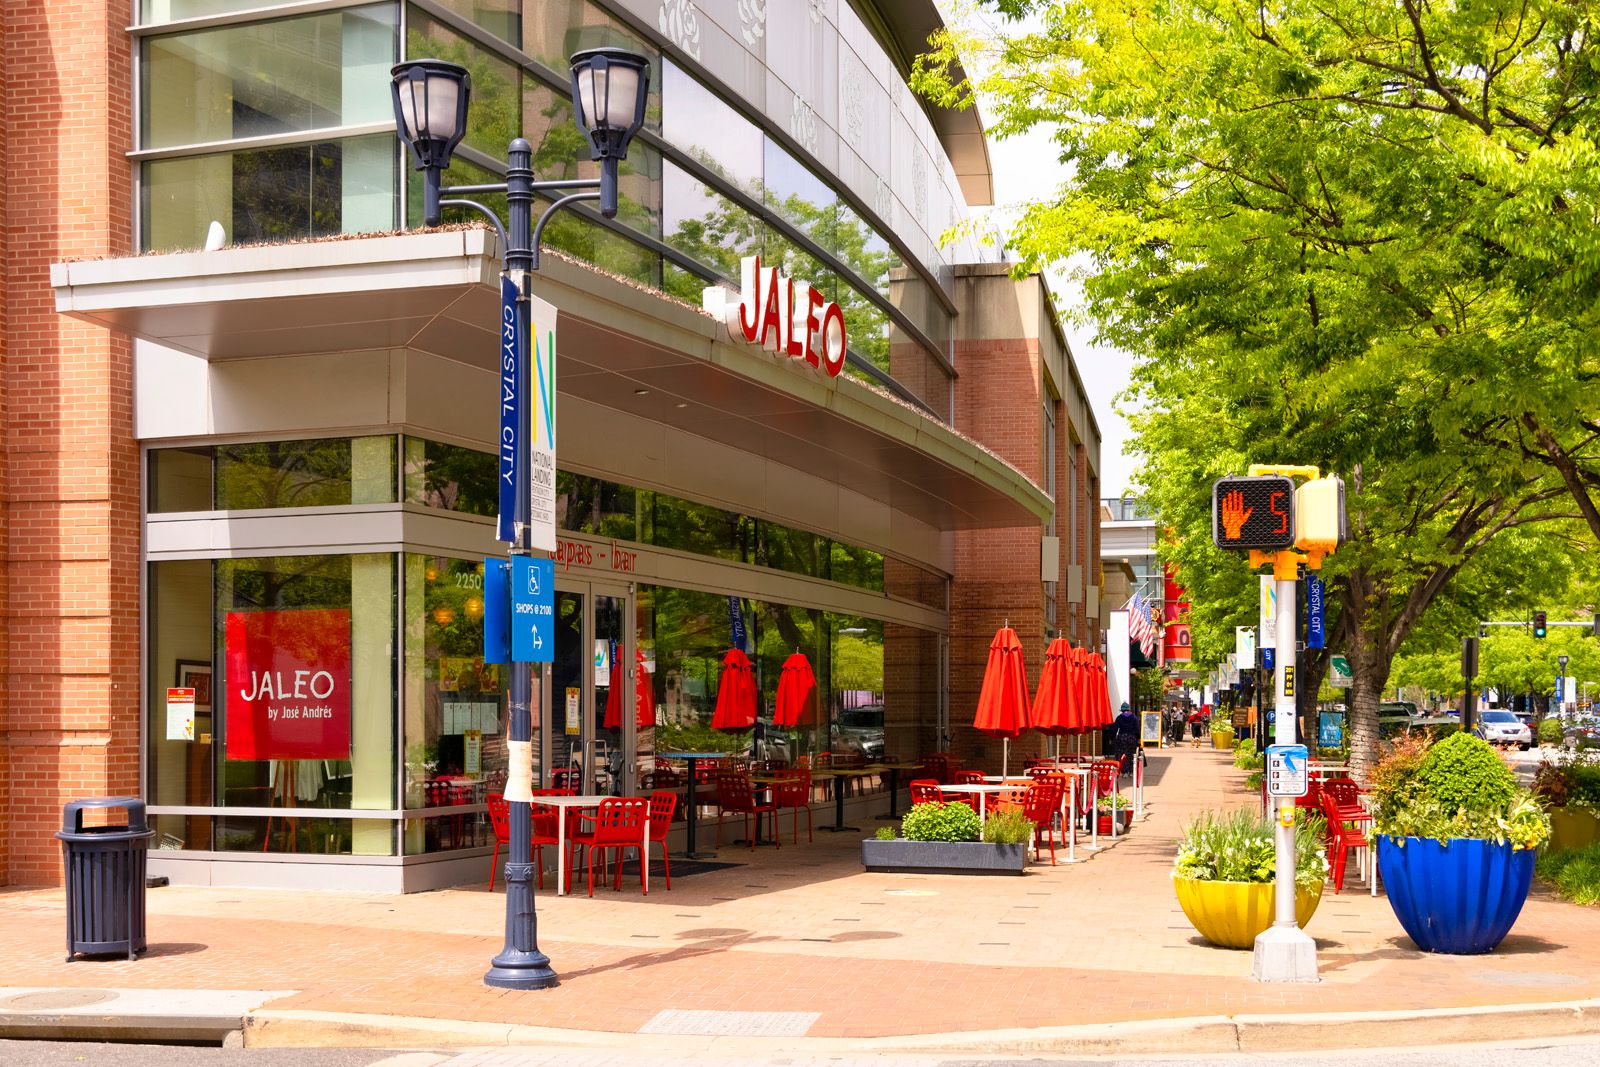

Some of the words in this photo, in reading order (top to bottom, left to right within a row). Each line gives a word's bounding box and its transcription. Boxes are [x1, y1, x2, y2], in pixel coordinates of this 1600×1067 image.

[739, 255, 847, 378] JALEO
[503, 305, 514, 417] CRYSTAL
[502, 426, 514, 486] CITY
[531, 450, 553, 471] NATIONAL
[531, 467, 552, 487] LANDING
[1269, 492, 1287, 535] 5
[611, 540, 637, 572] bar
[455, 572, 481, 590] 2250
[515, 602, 533, 615] SHOPS
[534, 604, 539, 615] @
[539, 605, 552, 616] 2100
[1311, 583, 1321, 615] CRYSTAL
[1311, 616, 1322, 634] CITY
[240, 669, 335, 702] JALEO
[267, 705, 278, 719] by
[281, 705, 299, 719] José
[302, 705, 332, 719] Andrés
